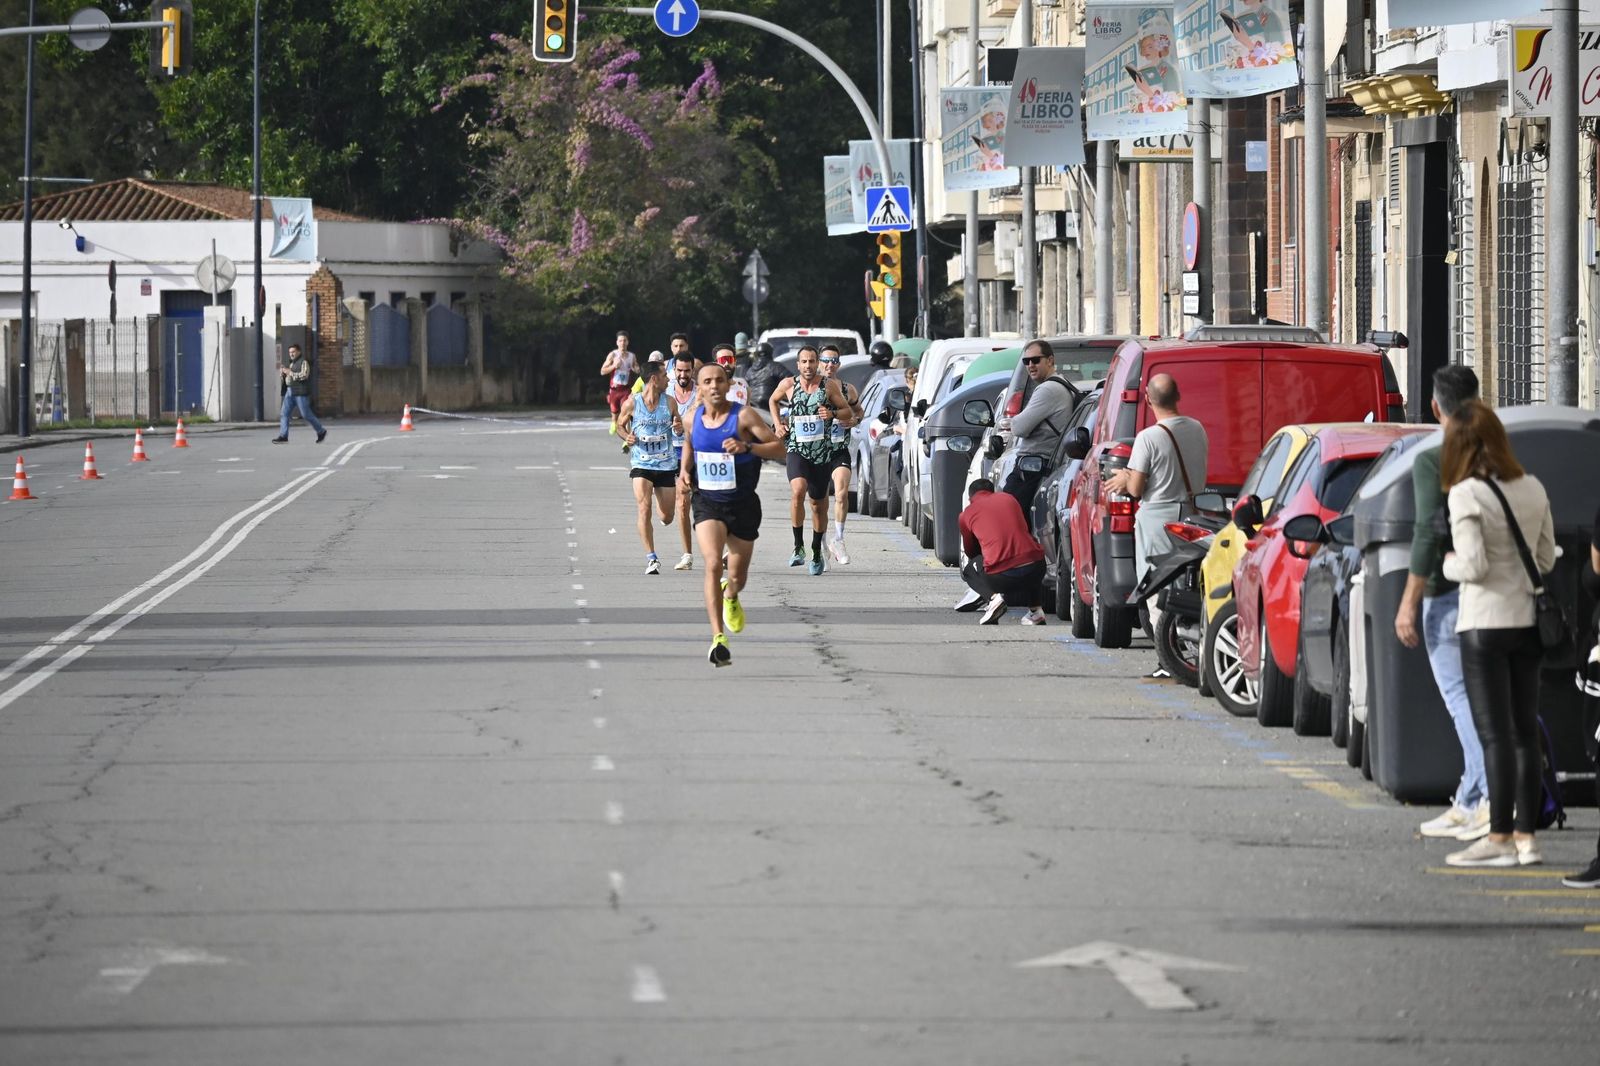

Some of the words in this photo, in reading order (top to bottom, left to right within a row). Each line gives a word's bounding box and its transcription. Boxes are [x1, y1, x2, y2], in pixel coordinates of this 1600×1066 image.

[1094, 26, 1122, 34] LIBRO
[1036, 92, 1074, 104] FERIA
[1515, 89, 1535, 111] unisex
[1021, 104, 1074, 118] LIBRO
[802, 422, 816, 432] 89
[644, 441, 660, 452] 111
[702, 462, 728, 476] 108
